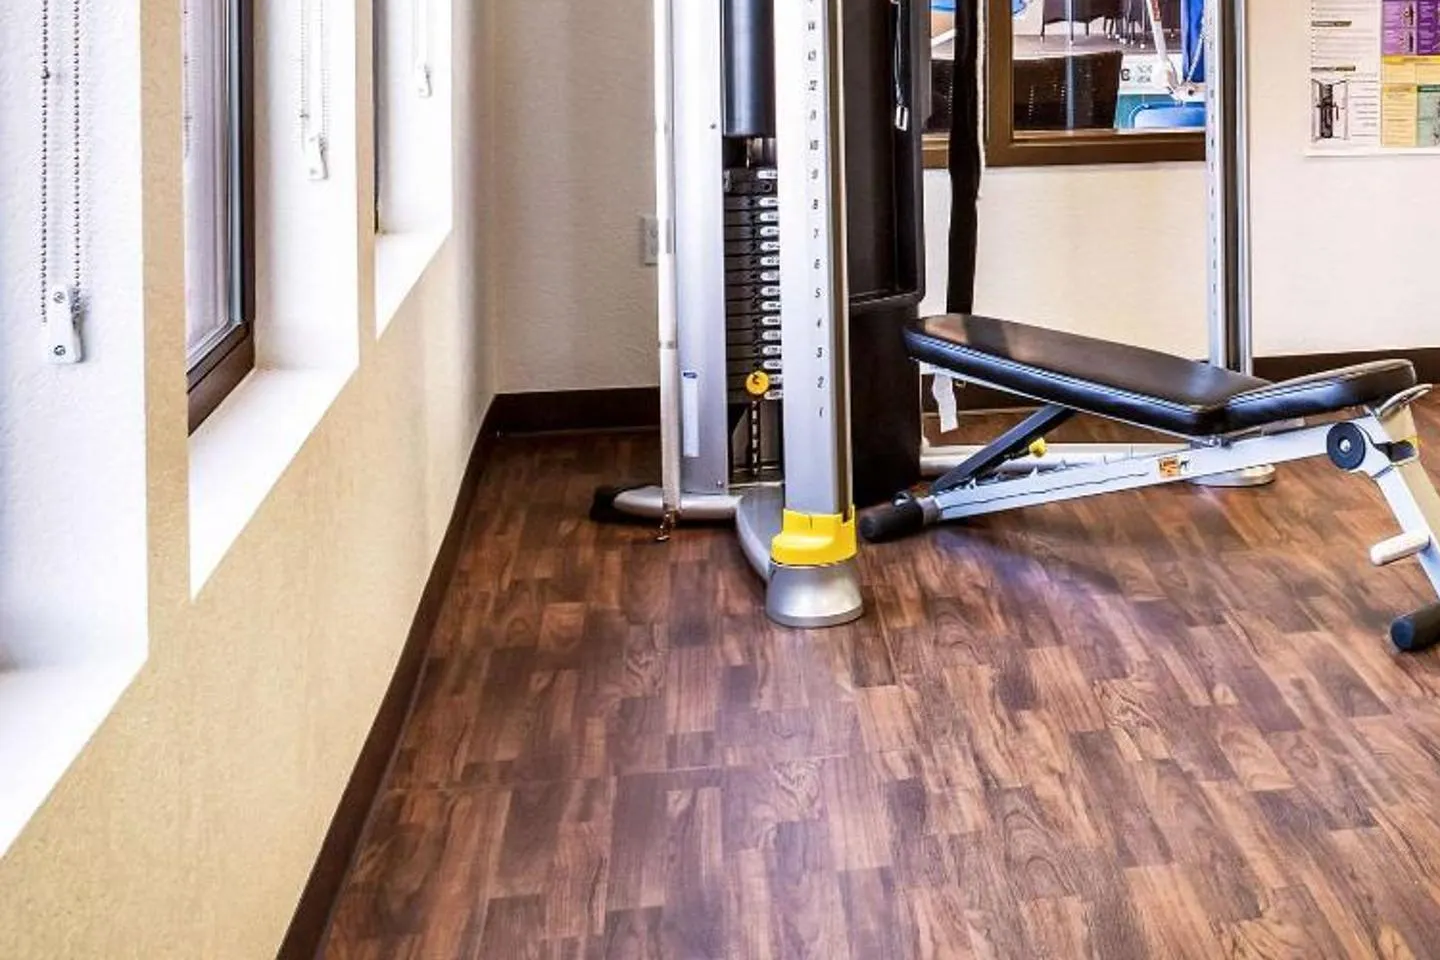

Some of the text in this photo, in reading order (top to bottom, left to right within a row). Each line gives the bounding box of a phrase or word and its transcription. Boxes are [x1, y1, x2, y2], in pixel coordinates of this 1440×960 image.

[814, 287, 821, 299] 5
[816, 346, 823, 358] 3
[817, 375, 824, 388] 2
